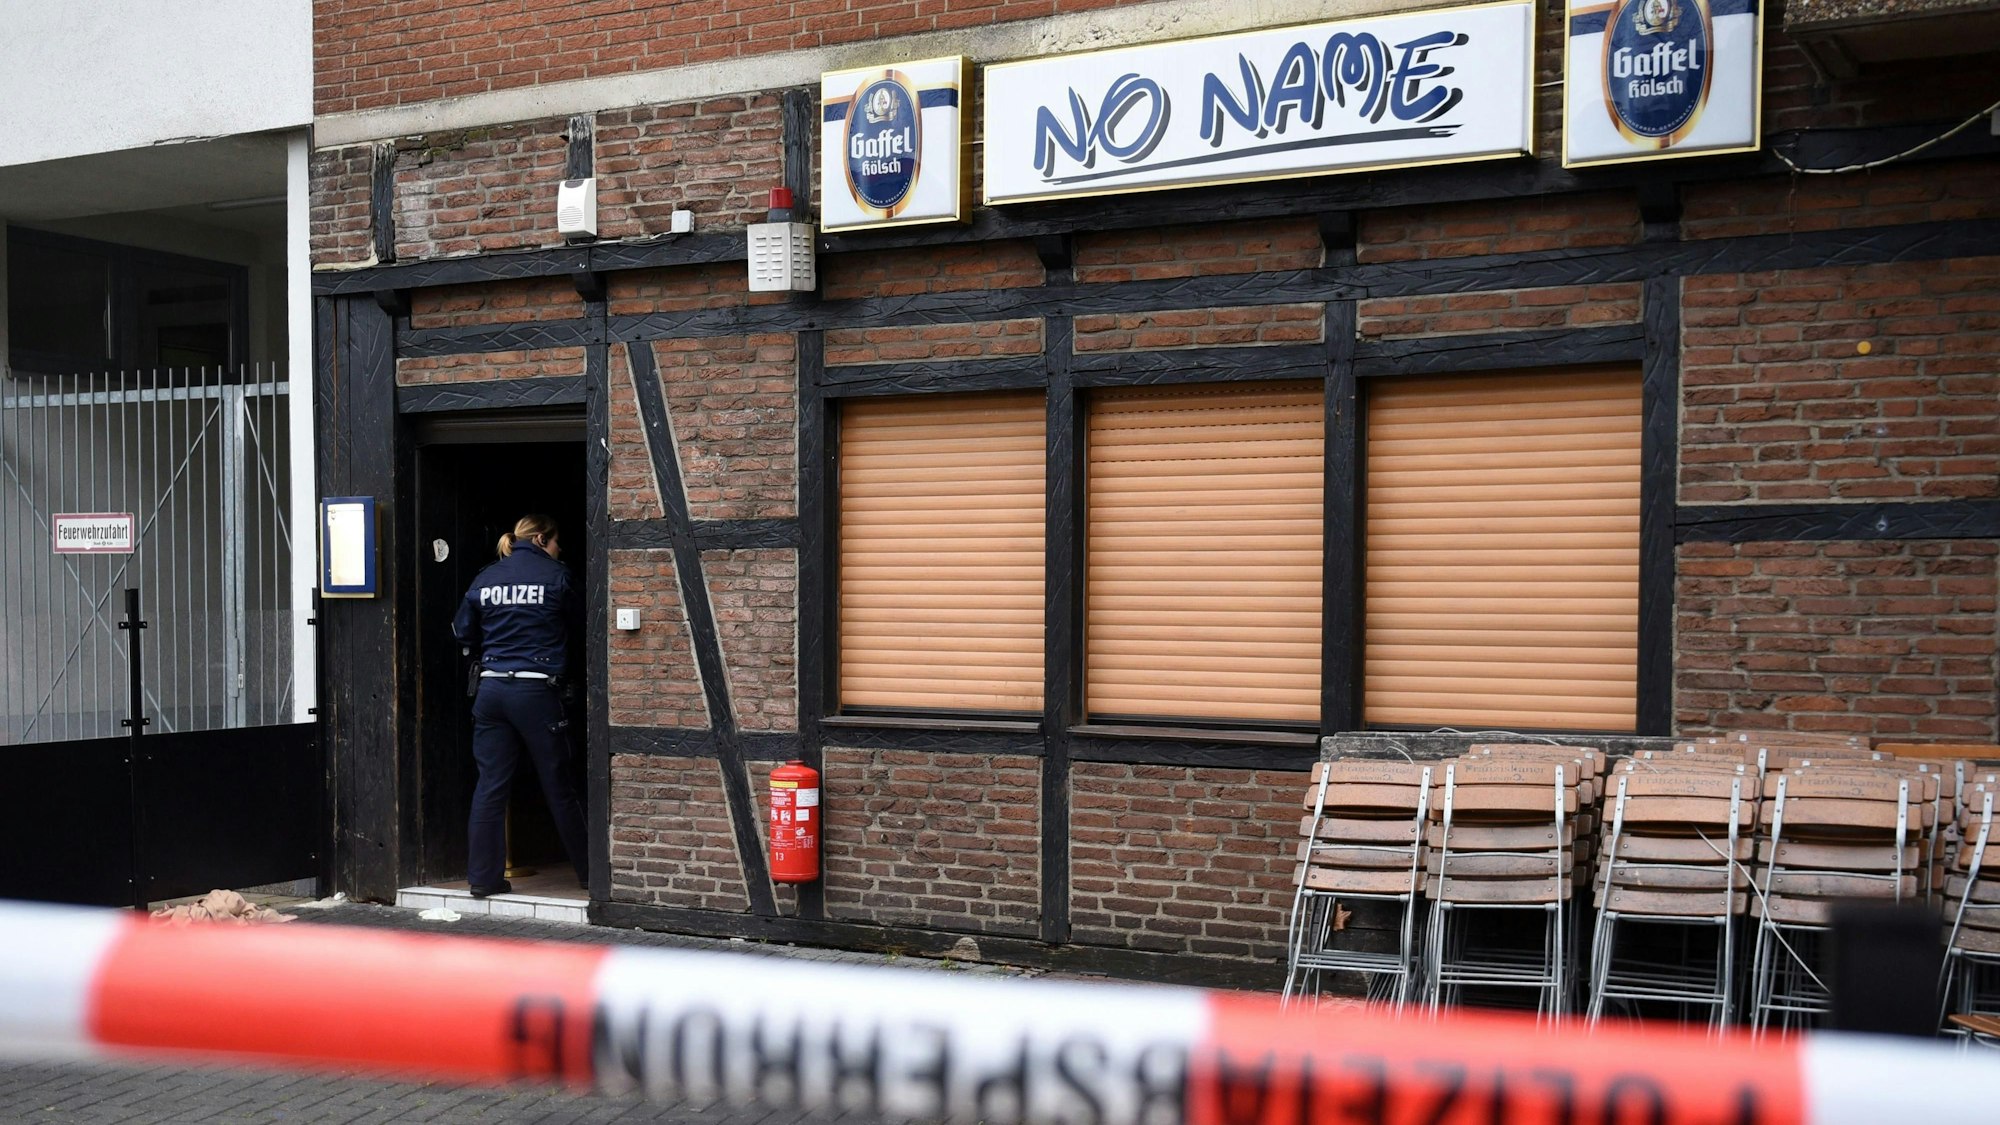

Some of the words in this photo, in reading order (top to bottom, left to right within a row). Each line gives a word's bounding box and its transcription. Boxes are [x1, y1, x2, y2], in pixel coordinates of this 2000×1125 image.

[1613, 38, 1701, 79] Gaffel
[1628, 76, 1684, 99] Kölsch
[1032, 73, 1171, 178] NO
[1199, 30, 1469, 148] NAME
[851, 126, 913, 159] Gaffel
[861, 158, 902, 177] Kölsch
[58, 524, 129, 540] Feuerwehrzufahrt
[480, 585, 545, 606] POLIZEI
